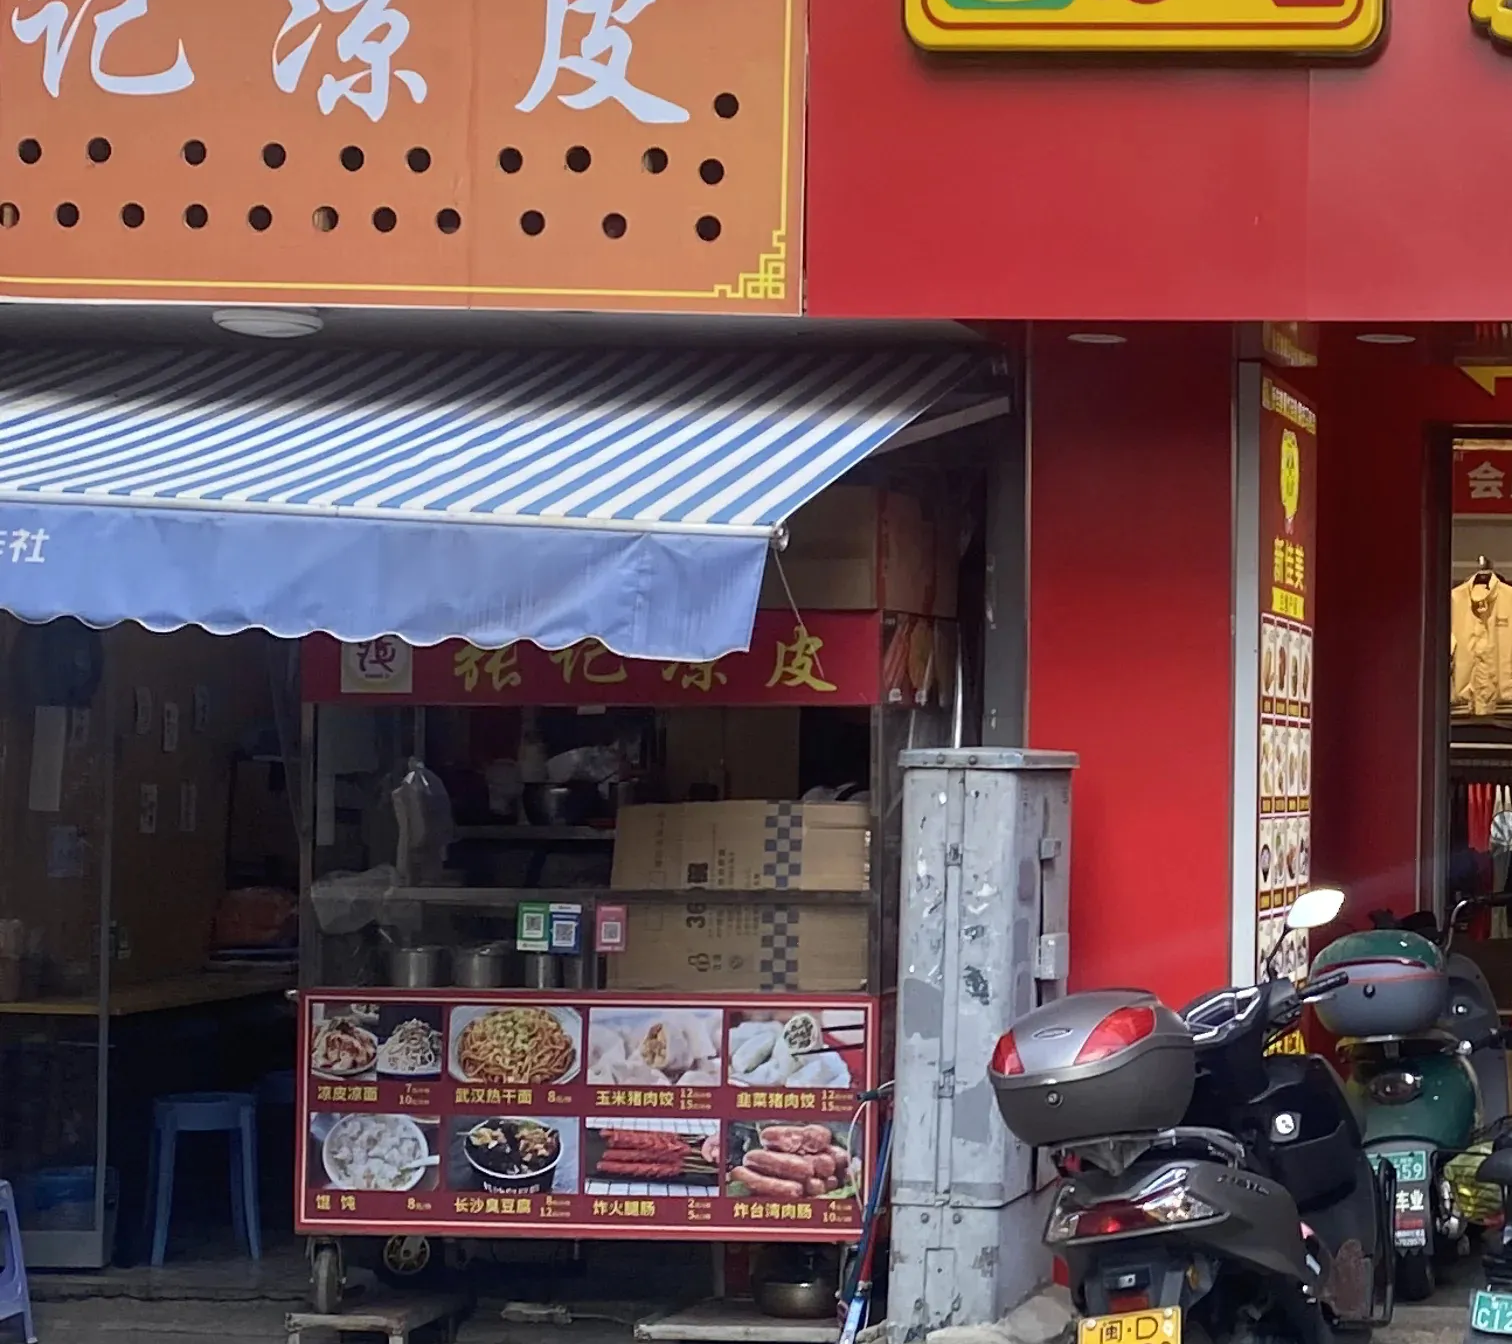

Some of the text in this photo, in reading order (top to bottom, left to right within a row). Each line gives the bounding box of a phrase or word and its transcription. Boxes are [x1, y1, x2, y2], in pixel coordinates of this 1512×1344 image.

[455, 1087, 533, 1106] 武汉热干面
[596, 1090, 675, 1108] 玉米猪肉饺
[736, 1092, 816, 1110] 韭菜猪肉饺
[454, 1197, 532, 1215] 长沙臭豆腐
[593, 1200, 656, 1217] 炸火腿肠
